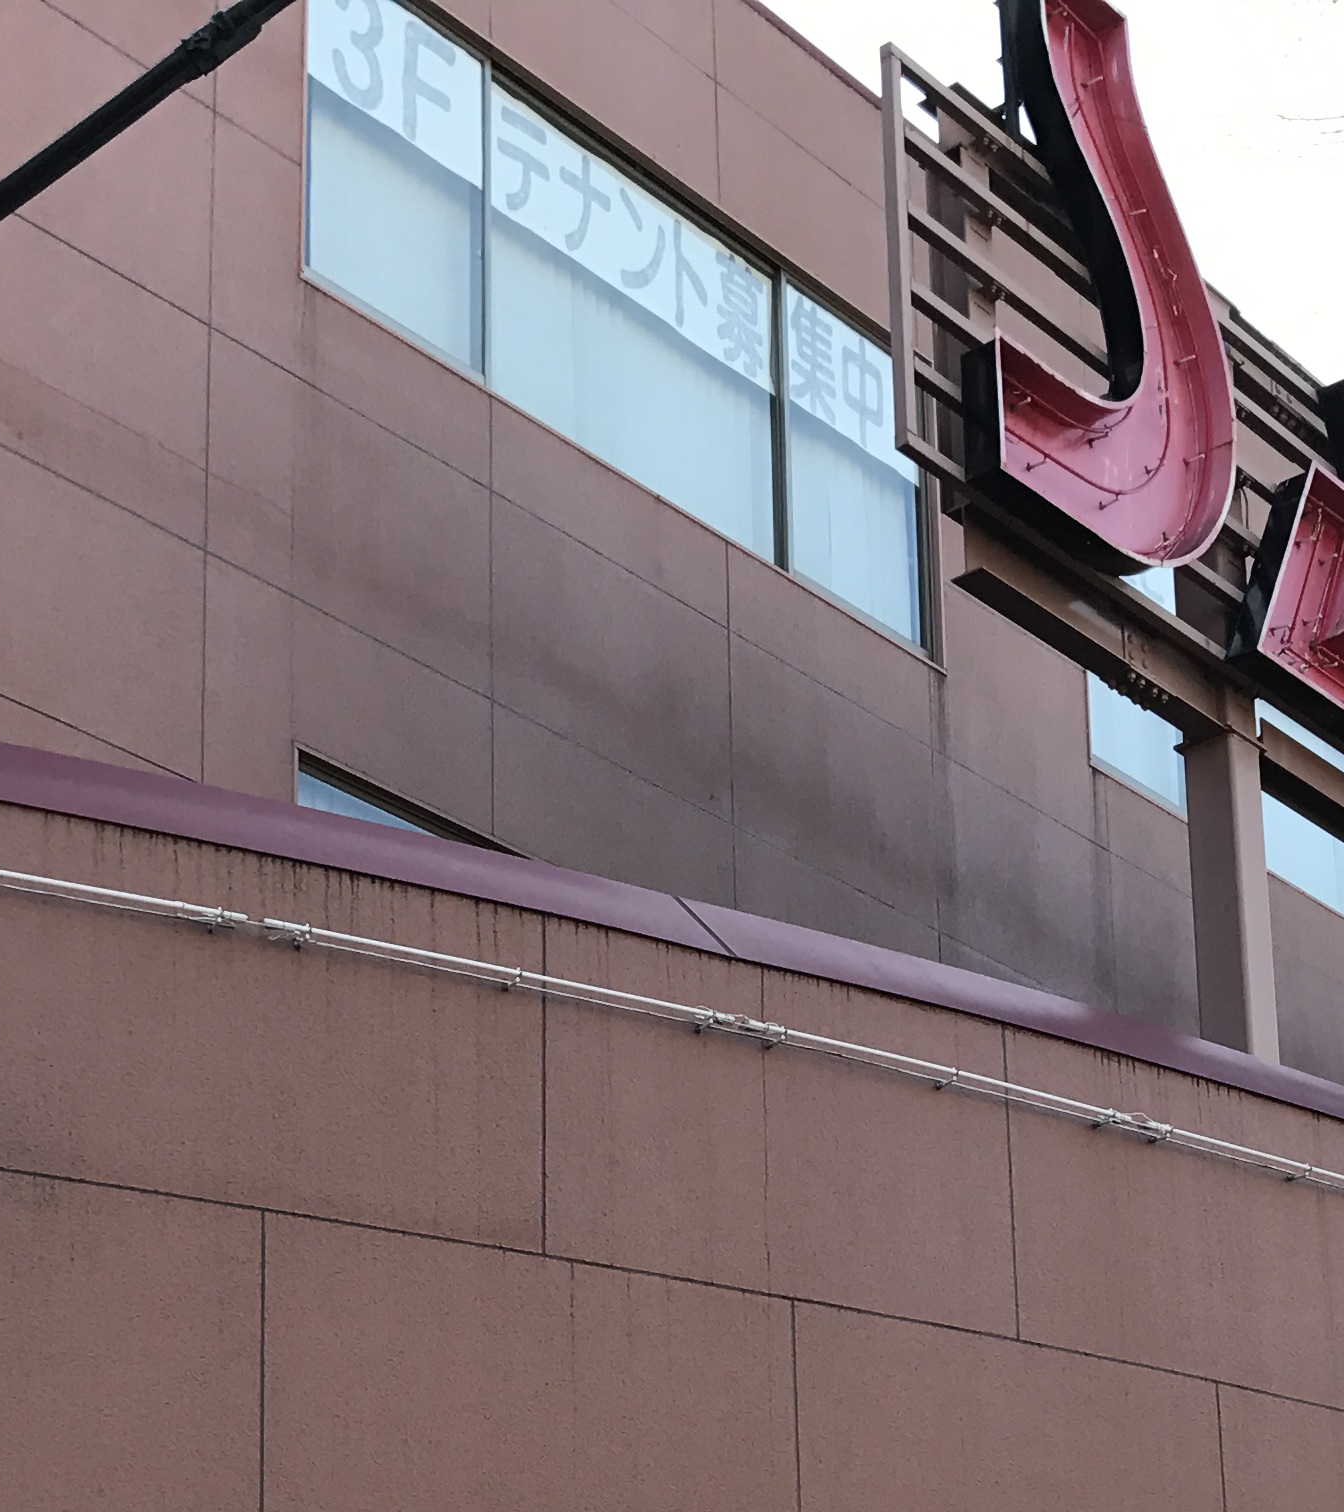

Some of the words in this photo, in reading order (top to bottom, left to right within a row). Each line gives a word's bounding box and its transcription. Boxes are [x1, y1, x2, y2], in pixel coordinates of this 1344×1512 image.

[331, 0, 456, 142] 3F
[496, 105, 885, 449] テナント募集中
